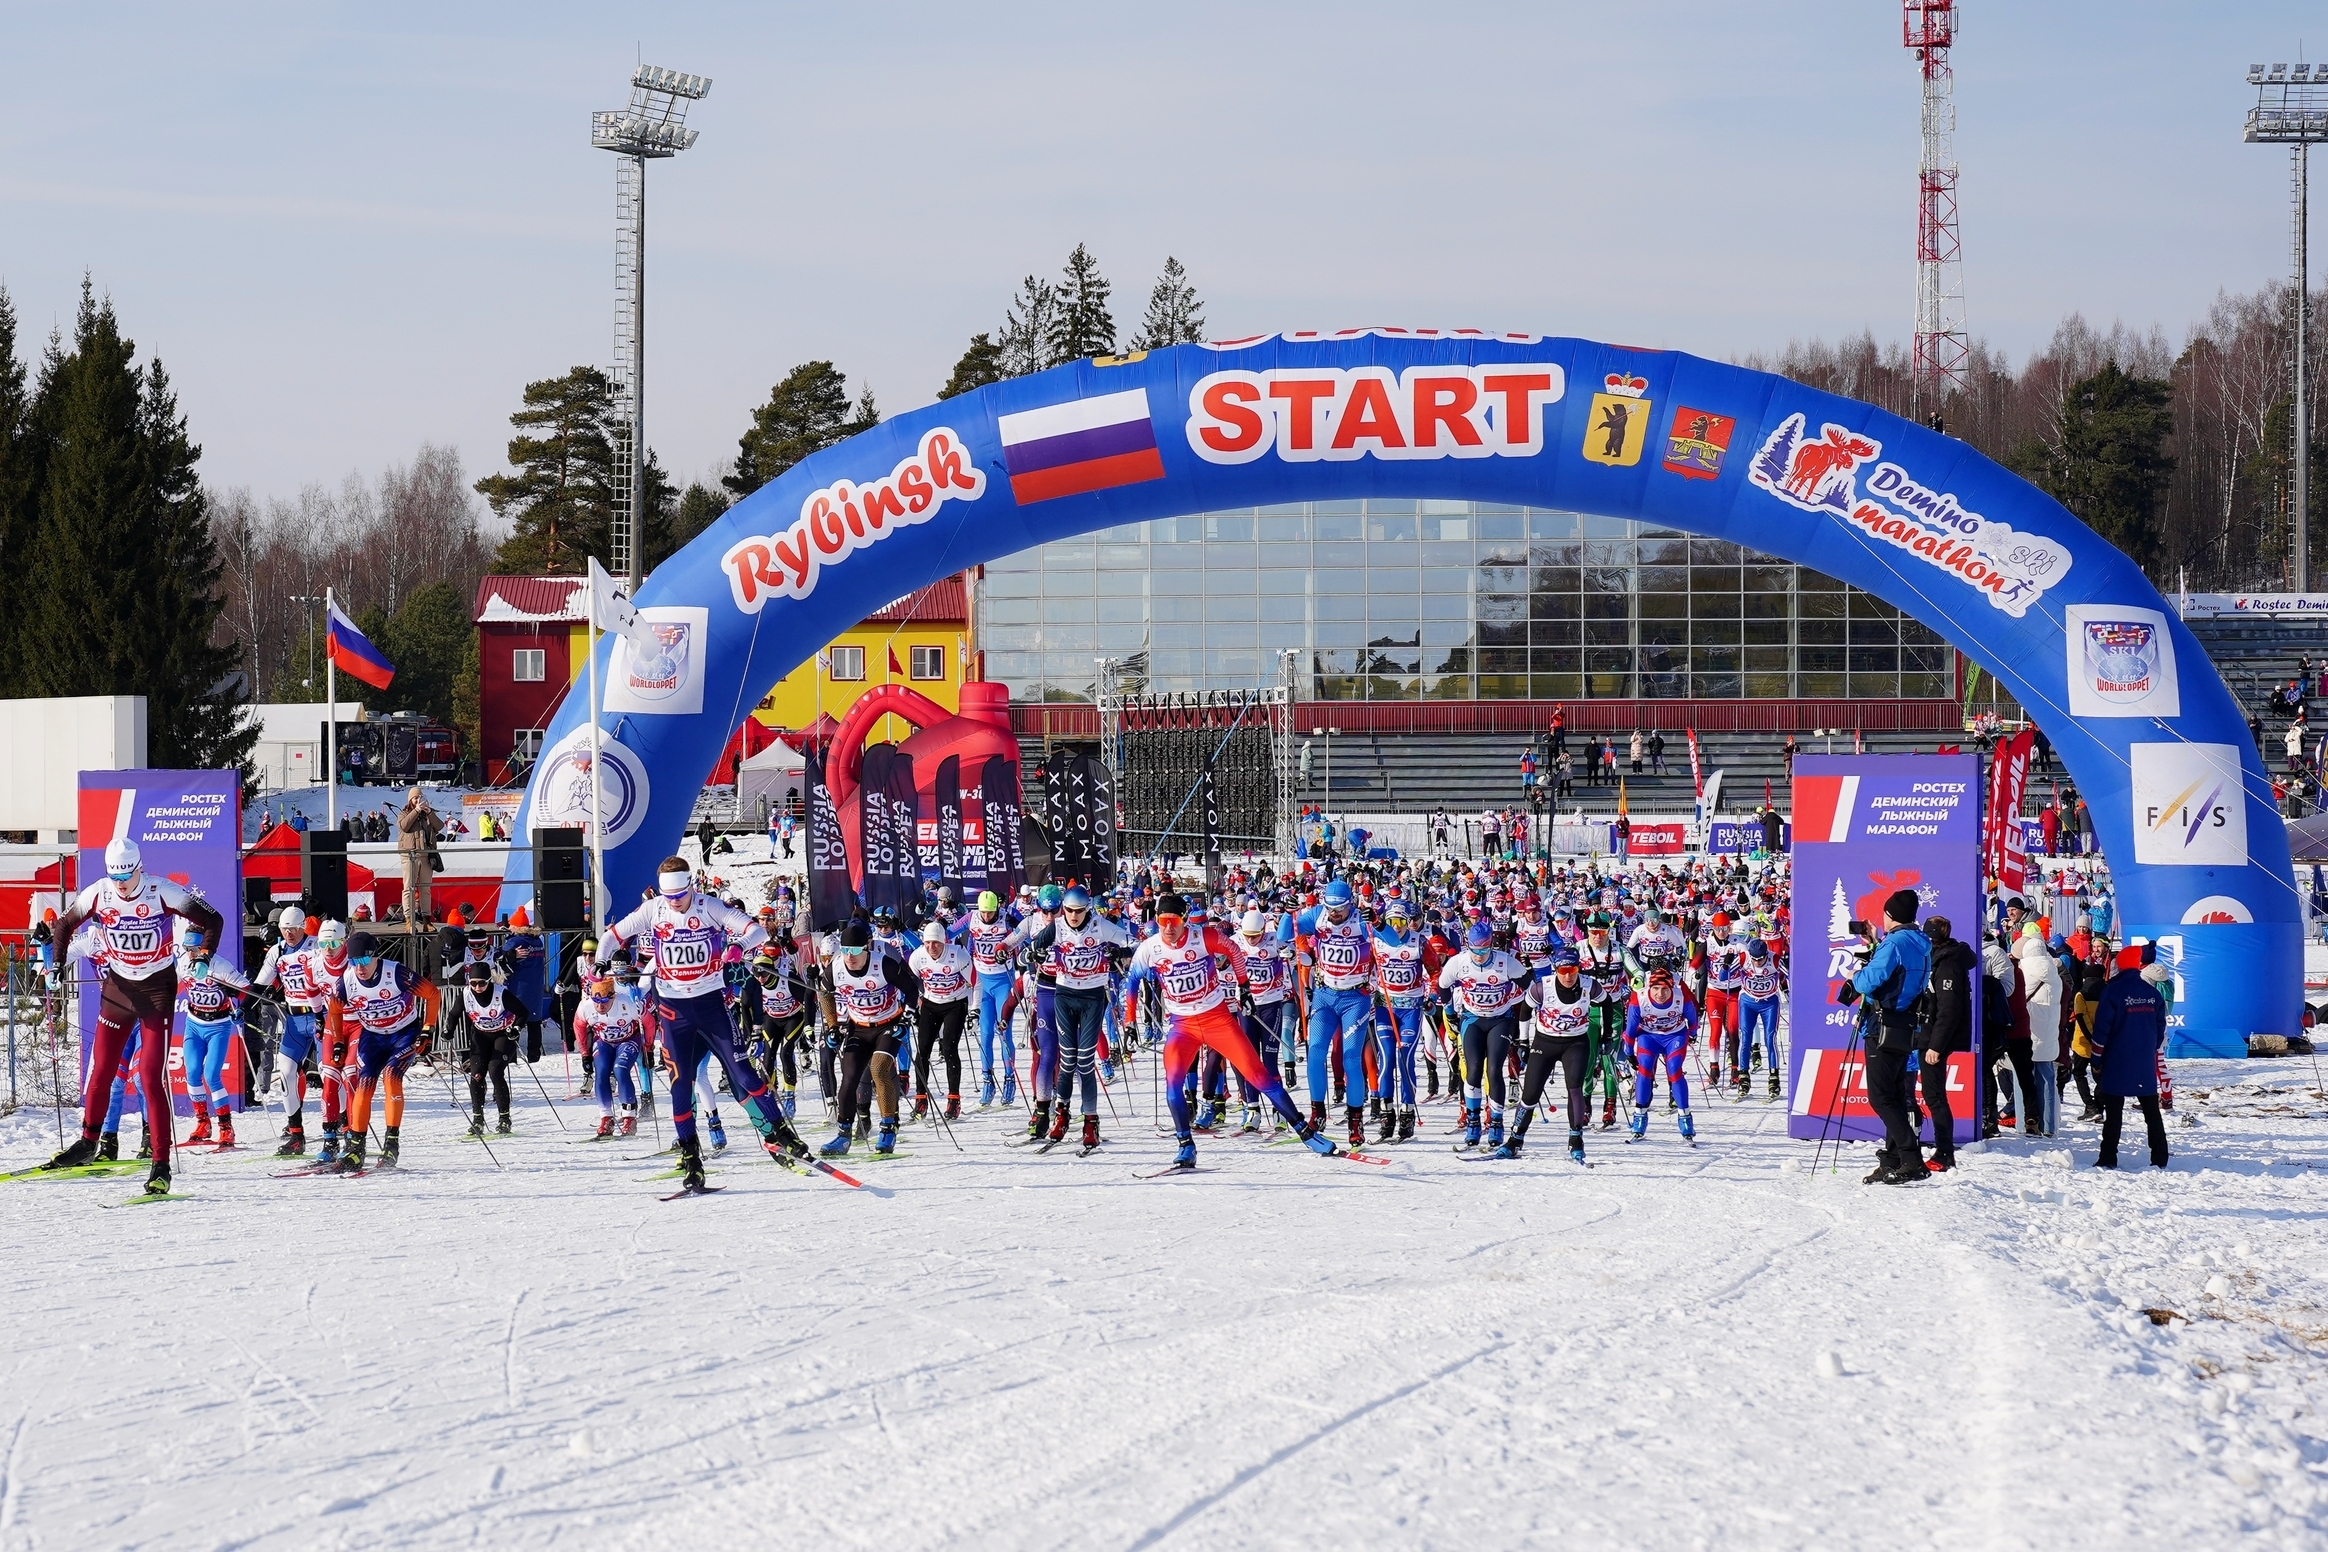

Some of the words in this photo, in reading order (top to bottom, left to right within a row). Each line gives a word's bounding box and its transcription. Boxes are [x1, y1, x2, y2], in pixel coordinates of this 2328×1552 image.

[1199, 373, 1551, 452] START
[1872, 467, 1980, 535] Demino
[731, 432, 977, 604] Rybinsk
[1853, 503, 2005, 593] marathon
[2009, 545, 2058, 577] ski
[2252, 599, 2292, 611] Rostec
[2109, 646, 2136, 656] SKI
[629, 675, 677, 690] WORLDLOPPET
[2097, 677, 2150, 692] WORLDLOPPET
[1912, 783, 1966, 793] РОСТЕХ
[181, 794, 227, 804] РОСТЕХ
[1871, 795, 1959, 808] ДЕМИНСКИЙ
[146, 805, 221, 818] ДЕМИНСКИЙ
[1048, 771, 1065, 861] MOAX
[1071, 773, 1092, 859] MOAX
[1204, 771, 1220, 852] MOAX
[1879, 809, 1949, 821] ЛЫЖНЫЙ
[153, 818, 212, 829] ЛЫЖНЫЙ
[813, 784, 830, 870] RUSSIA
[1866, 824, 1938, 835] МАРАФОН
[142, 832, 203, 842] МАРАФОН
[866, 792, 881, 874] RUSSIA
[880, 793, 894, 875] LOPPET
[1631, 832, 1677, 844] TEBOIL
[139, 905, 147, 914] 30
[689, 917, 698, 927] 30
[110, 932, 153, 950] 1207
[976, 942, 995, 955] 122
[665, 944, 705, 966] 1206
[1186, 951, 1195, 960] 30
[1322, 945, 1353, 964] 1220
[1068, 955, 1098, 970] 1227
[1247, 968, 1268, 982] 259
[1382, 969, 1412, 984] 1233
[1168, 973, 1203, 995] 1201
[1747, 980, 1771, 991] 1239
[190, 992, 218, 1006] 1226
[1825, 1009, 1850, 1027] ski
